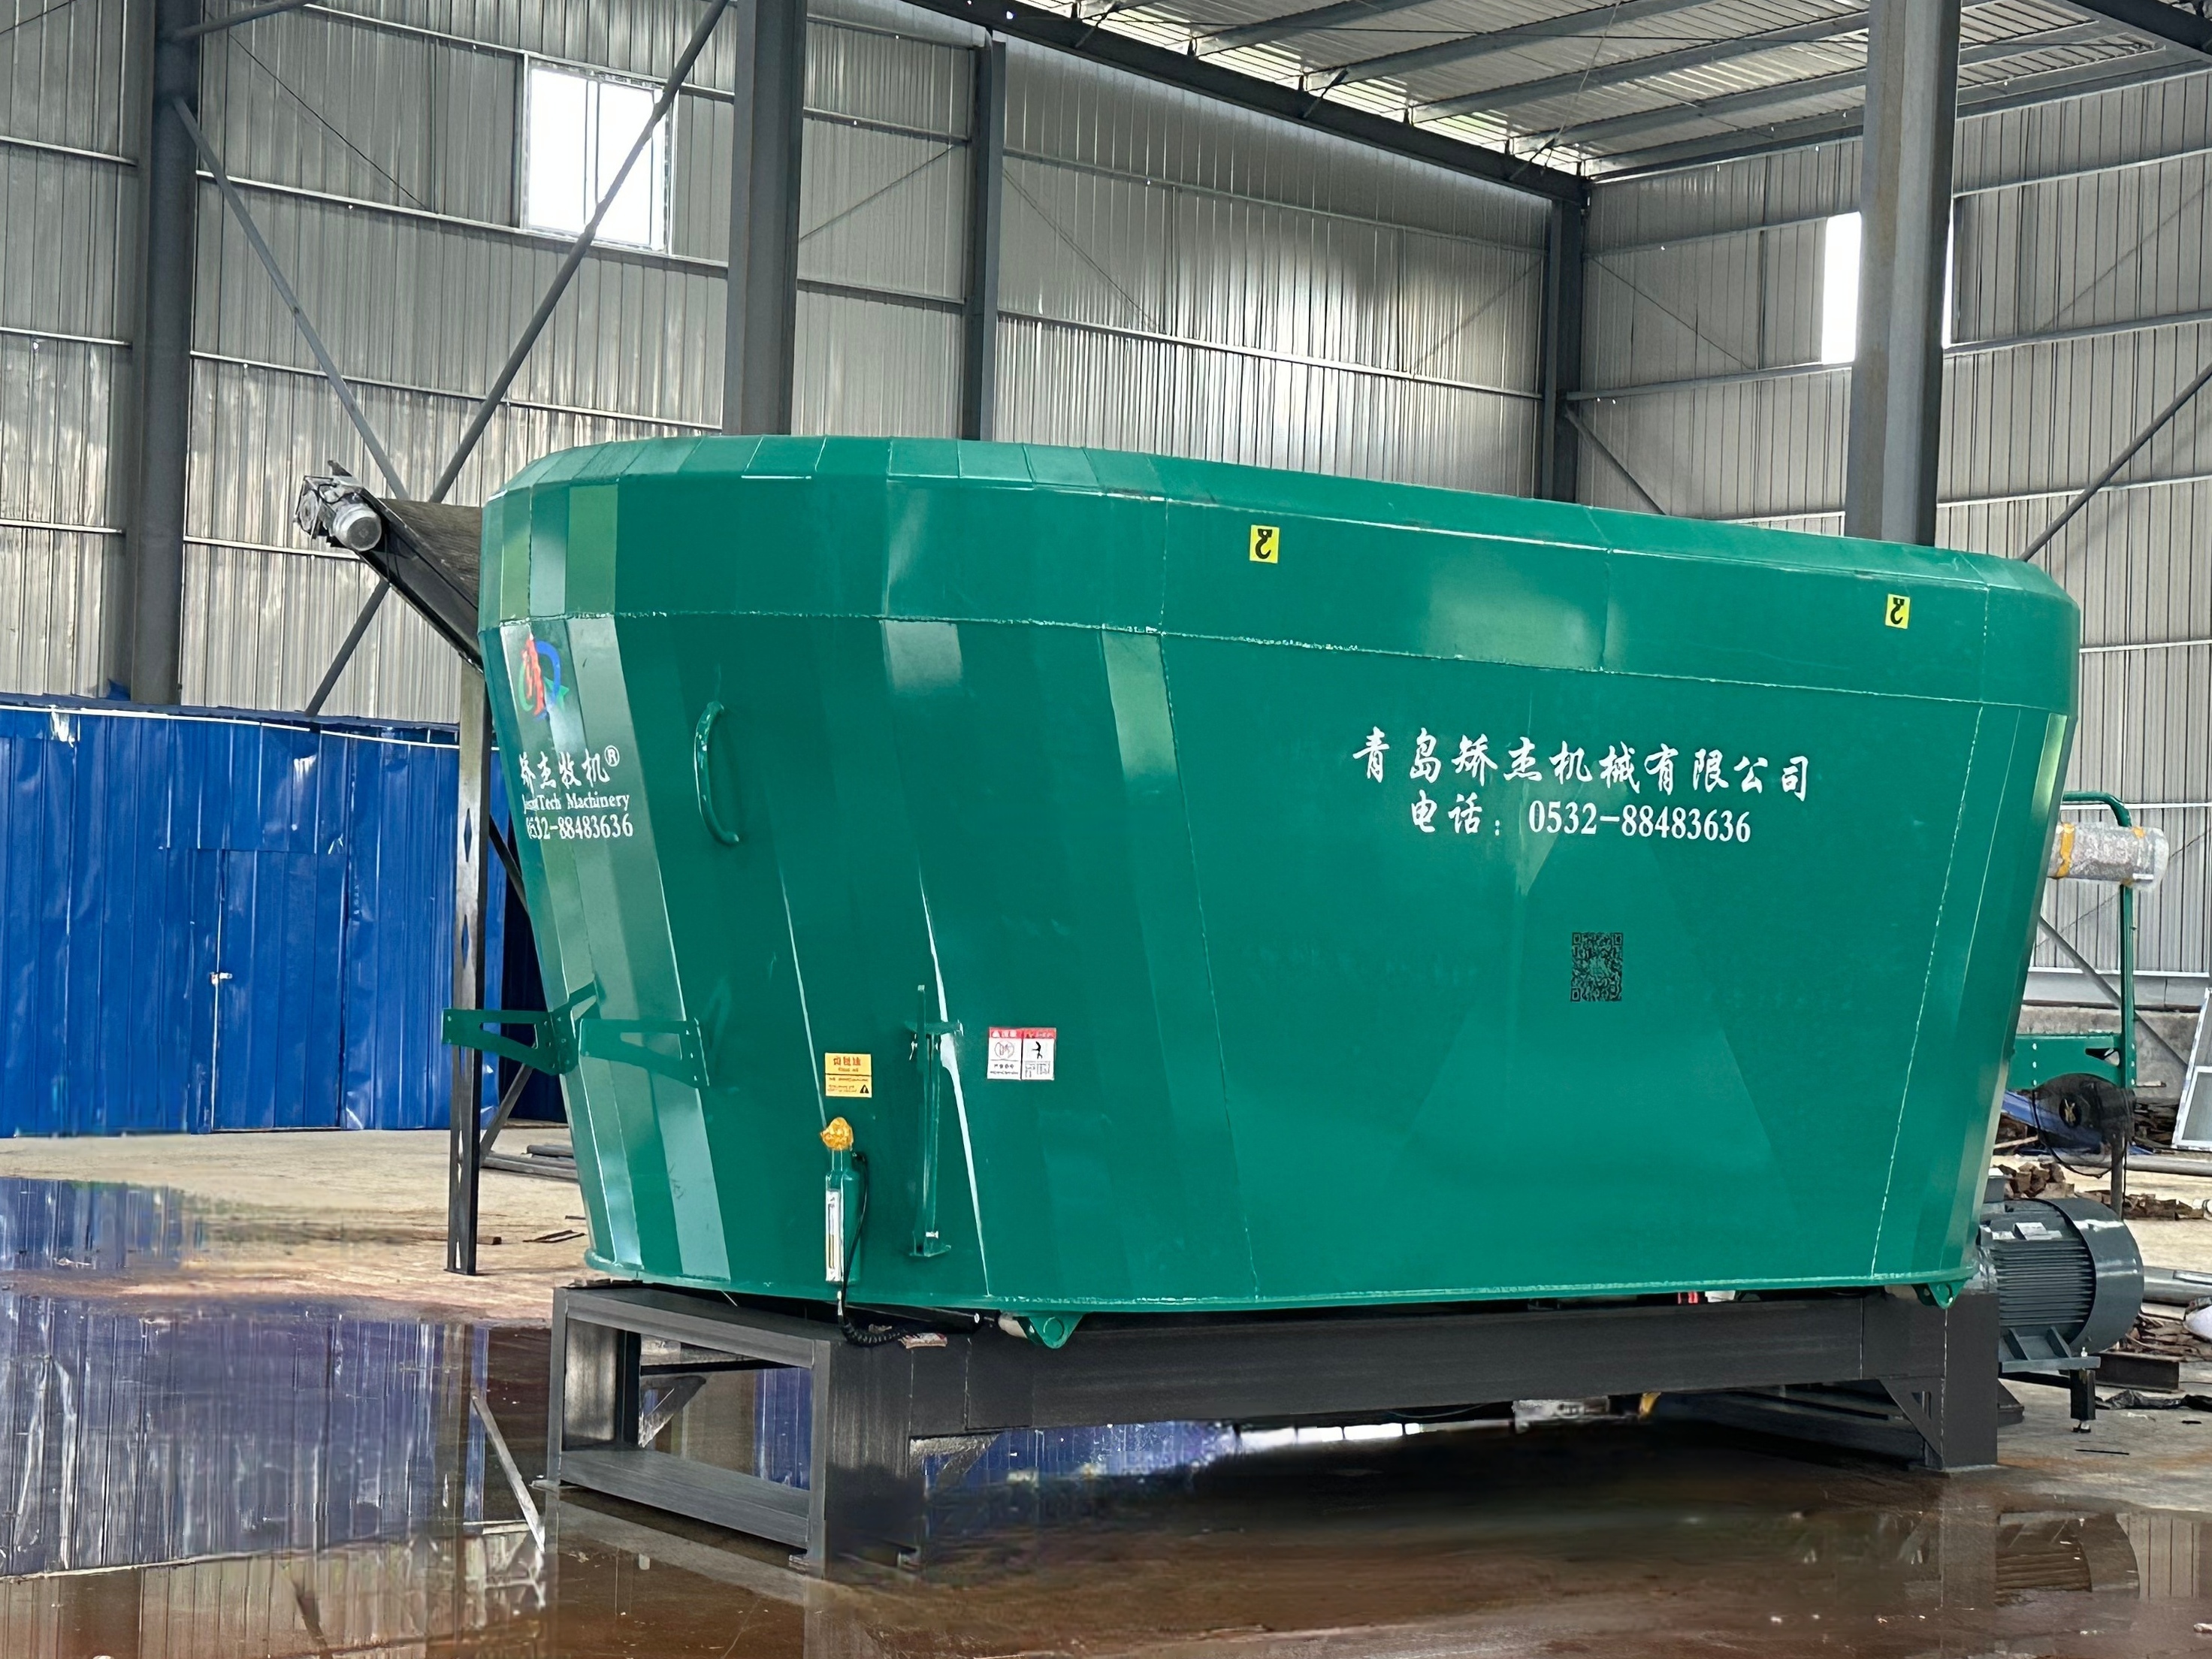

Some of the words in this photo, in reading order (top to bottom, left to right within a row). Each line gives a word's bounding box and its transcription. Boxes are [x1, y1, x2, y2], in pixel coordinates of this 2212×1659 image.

[1352, 726, 1809, 802] 青岛矫杰机械有限公司
[565, 790, 630, 811] Machinery
[1528, 799, 1751, 843] 0532-88483636
